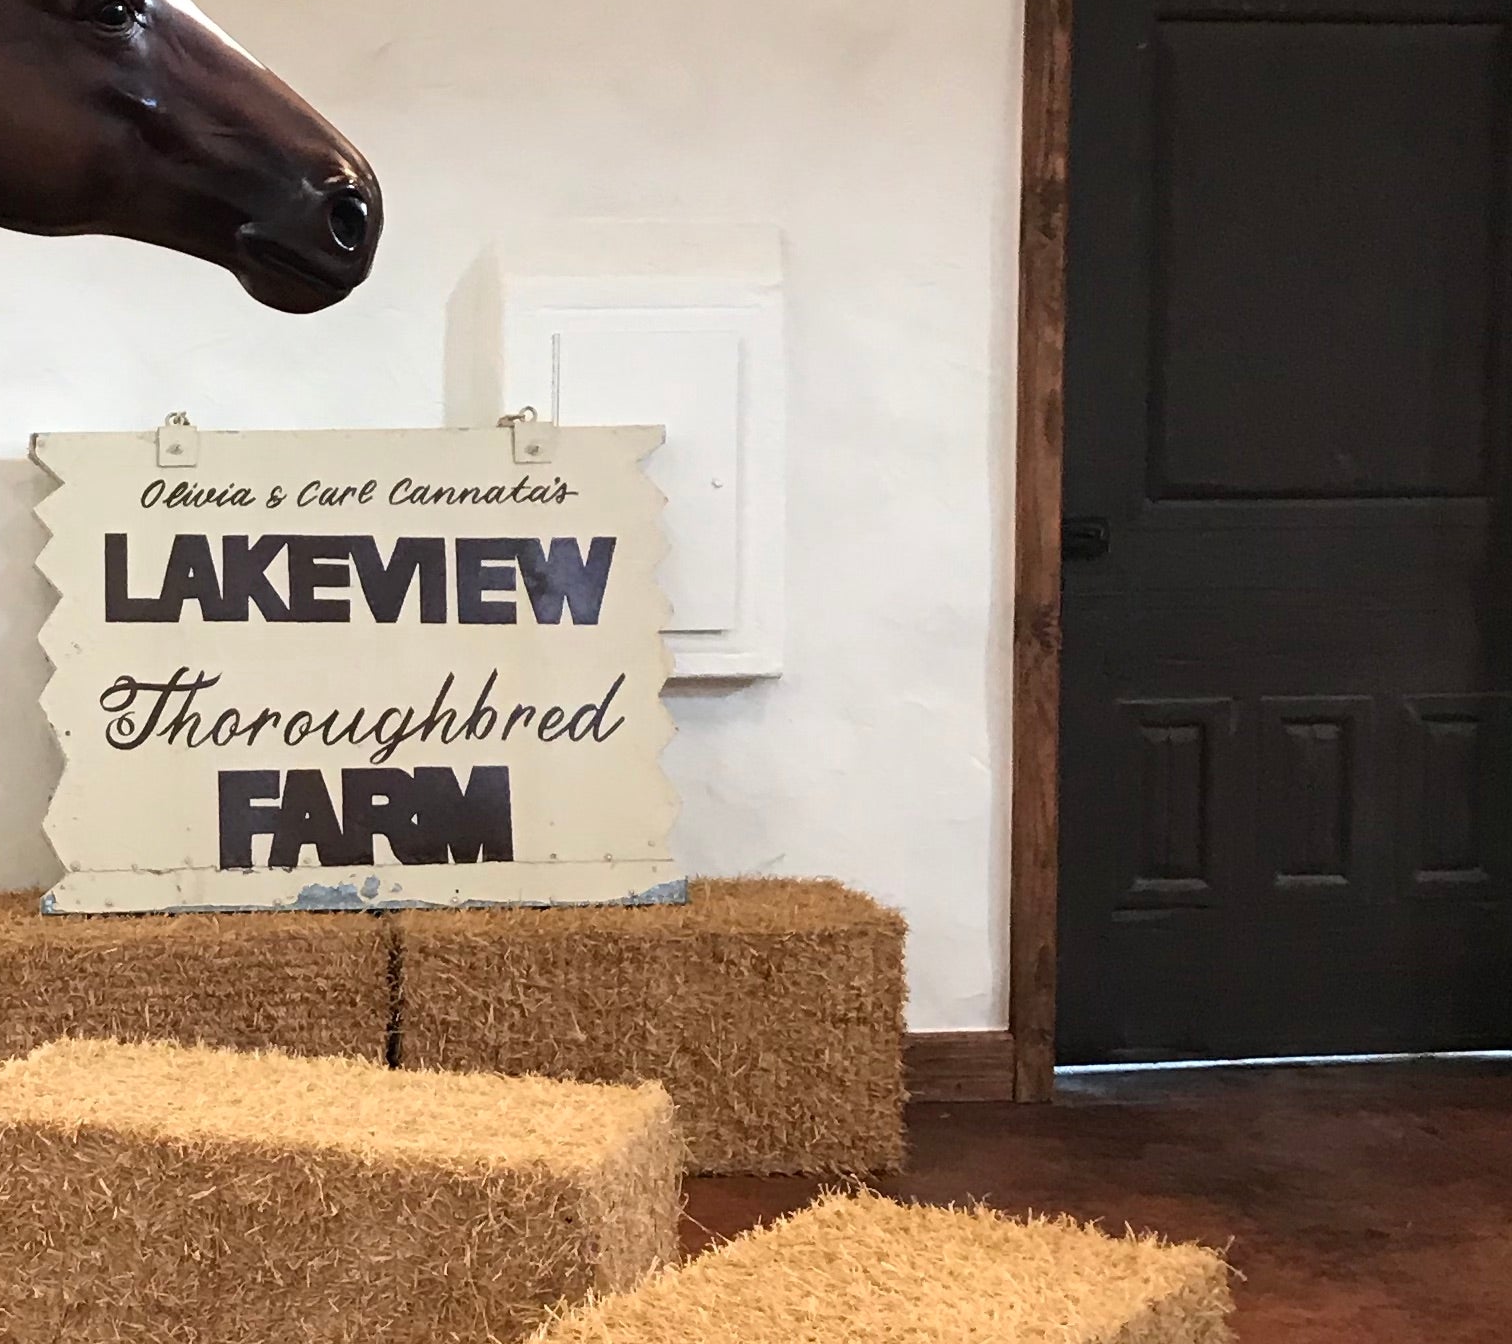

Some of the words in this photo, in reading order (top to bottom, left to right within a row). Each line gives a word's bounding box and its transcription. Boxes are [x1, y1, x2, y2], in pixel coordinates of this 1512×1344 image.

[140, 479, 256, 510] Olivia
[269, 487, 287, 508] &
[297, 480, 378, 506] Carl
[388, 476, 579, 506] Cannata's
[104, 533, 618, 625] LAKEVIEW
[99, 666, 627, 764] Thoroughbred
[218, 765, 515, 870] FARM
